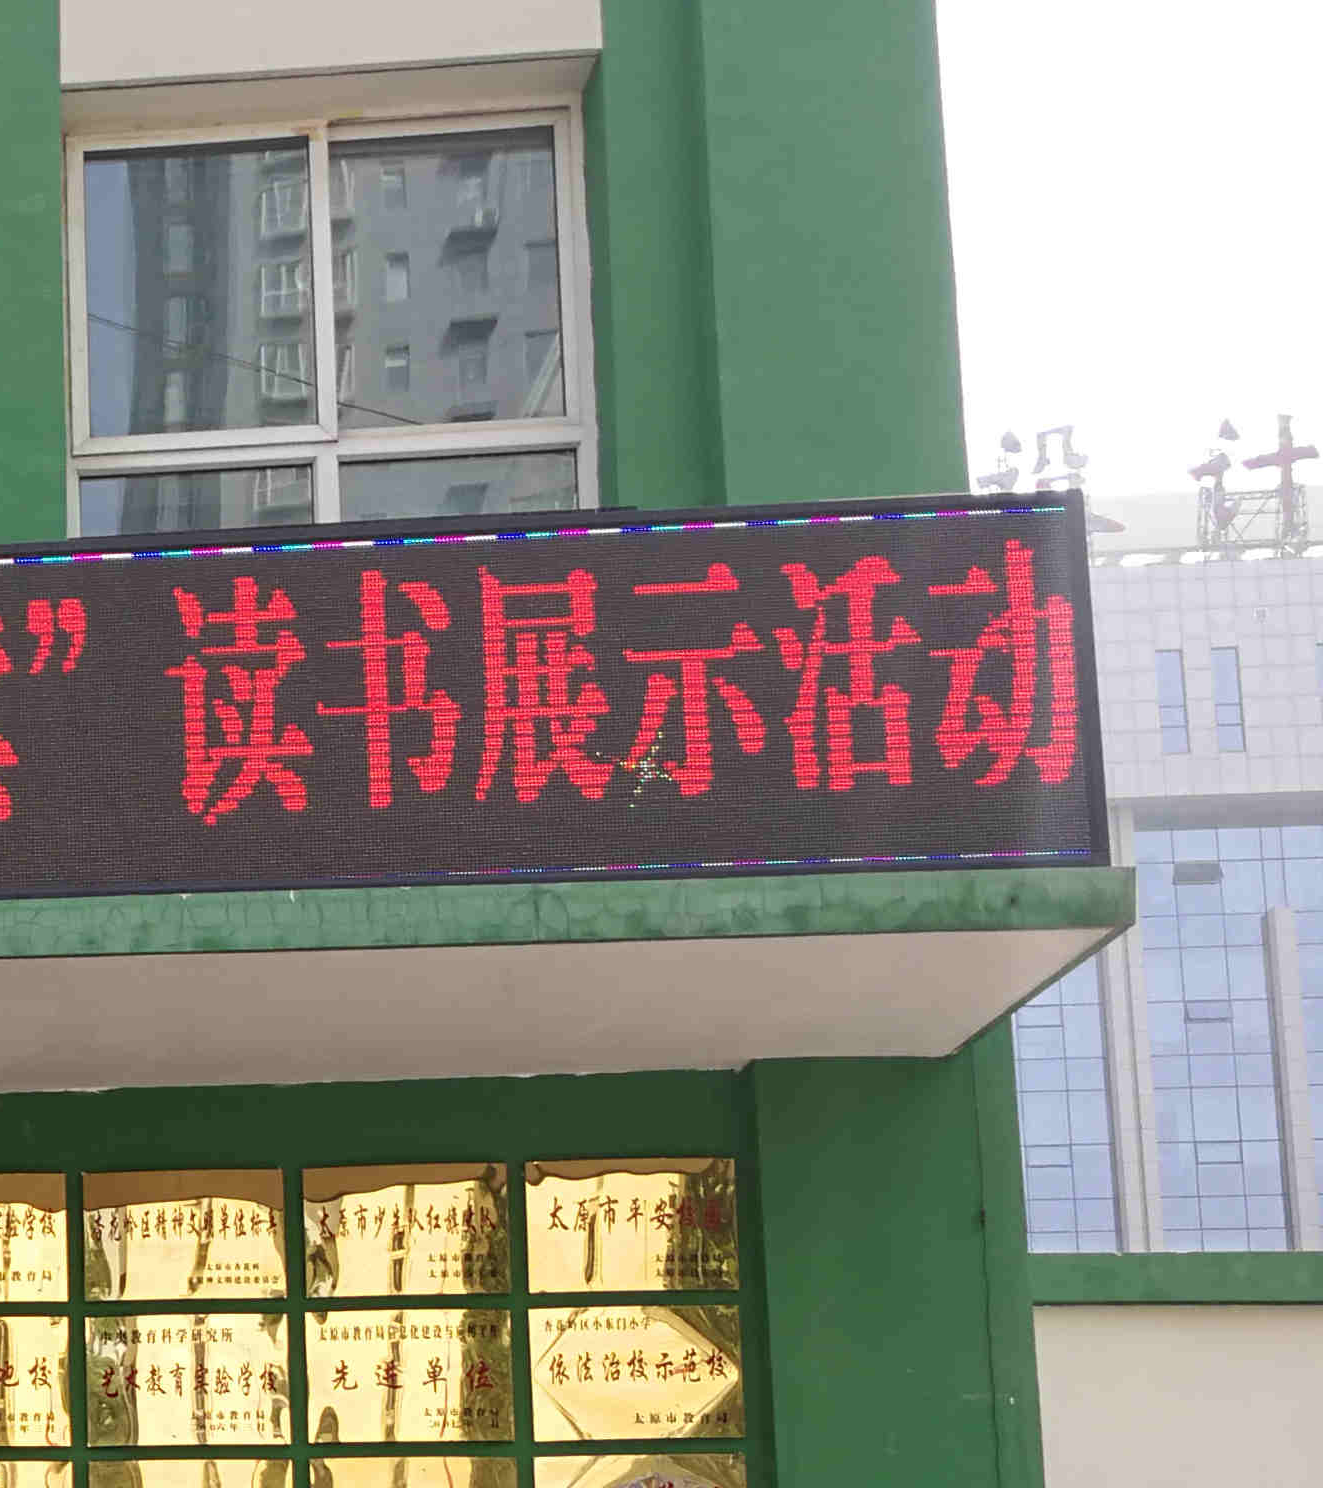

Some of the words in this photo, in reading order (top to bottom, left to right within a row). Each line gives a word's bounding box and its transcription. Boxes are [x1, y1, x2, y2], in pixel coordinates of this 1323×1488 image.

[101, 1361, 277, 1397] 艺术教育实验学校
[331, 1356, 494, 1393] 先进单位
[549, 1348, 728, 1384] 依法治校示范校
